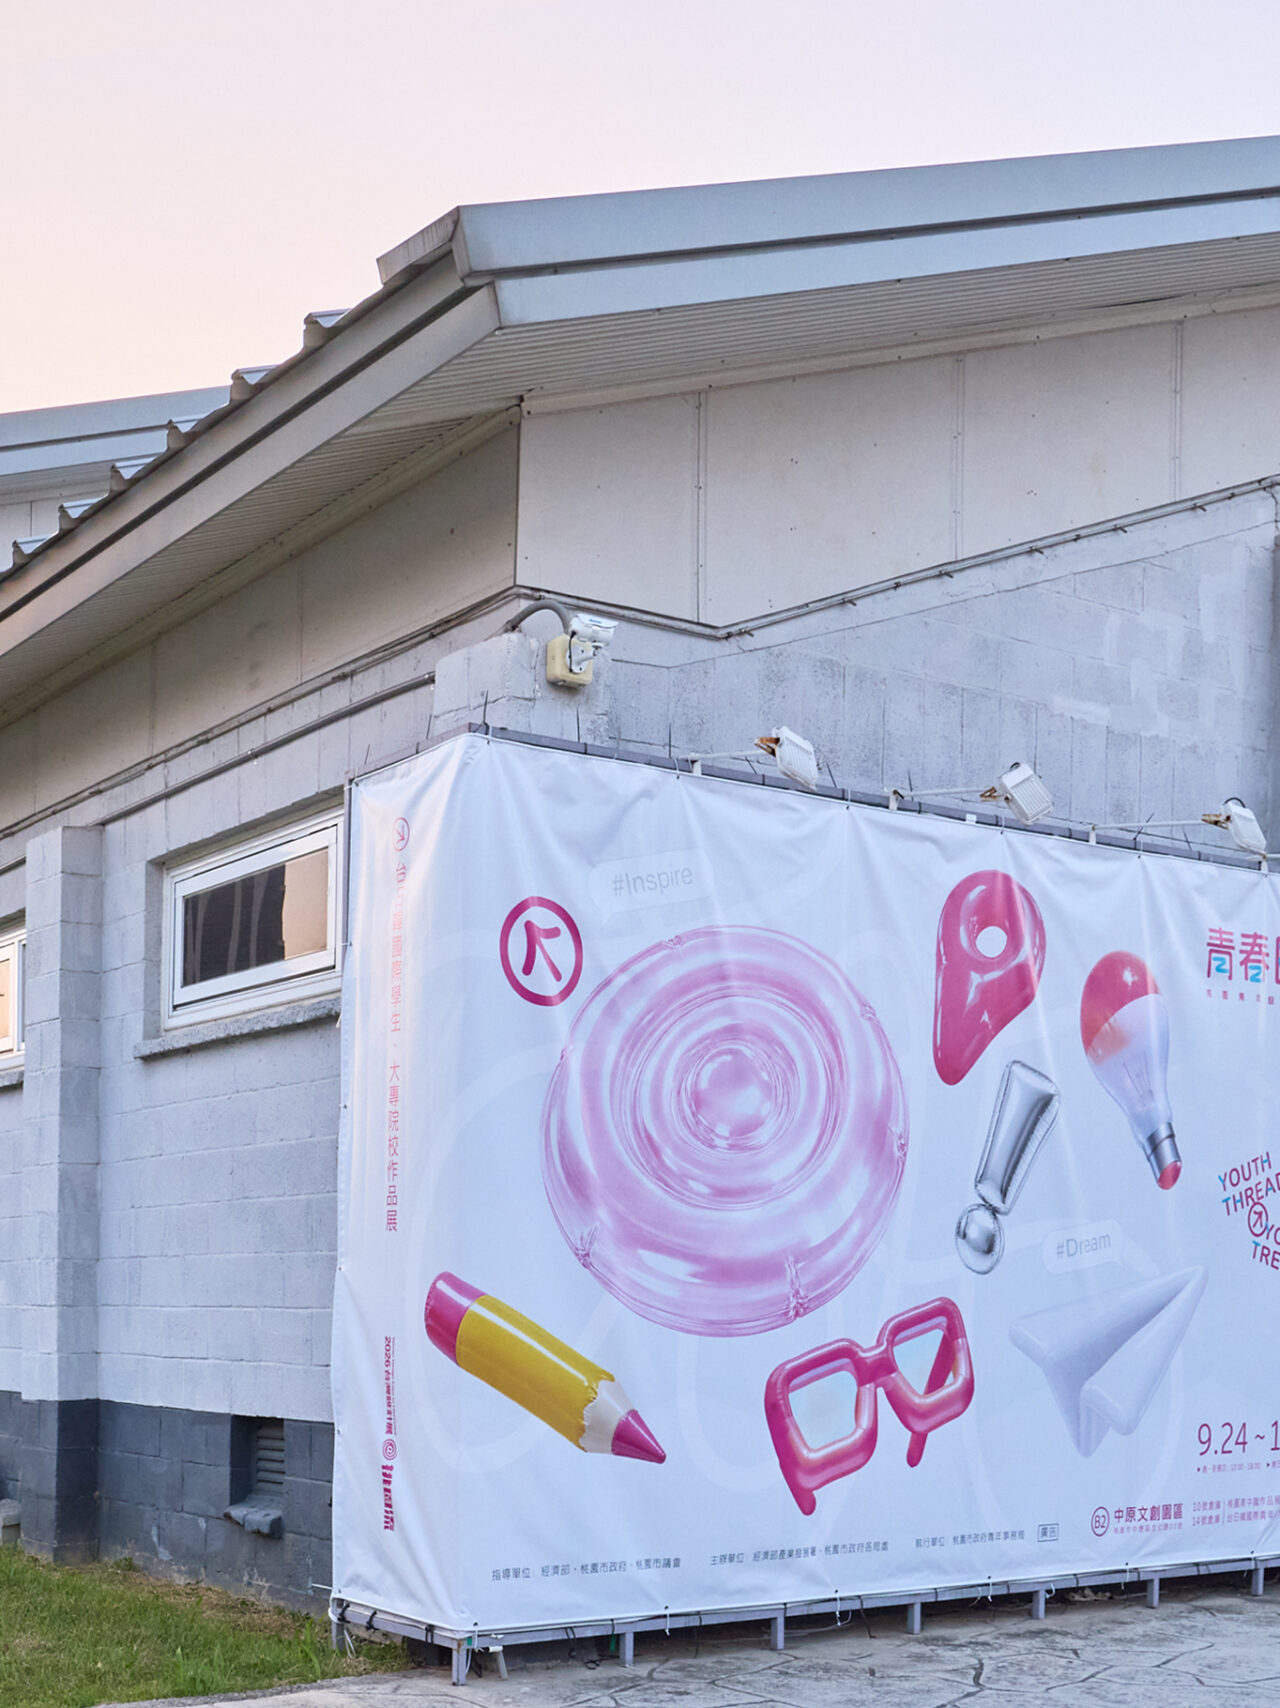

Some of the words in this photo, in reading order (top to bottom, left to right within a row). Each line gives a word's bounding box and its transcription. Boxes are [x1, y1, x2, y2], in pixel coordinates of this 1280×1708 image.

[612, 863, 693, 897] #Inspire
[1218, 1151, 1272, 1192] YOUTH
[1056, 1232, 1112, 1261] #Dream
[1114, 1503, 1184, 1525] 中原文創園區
